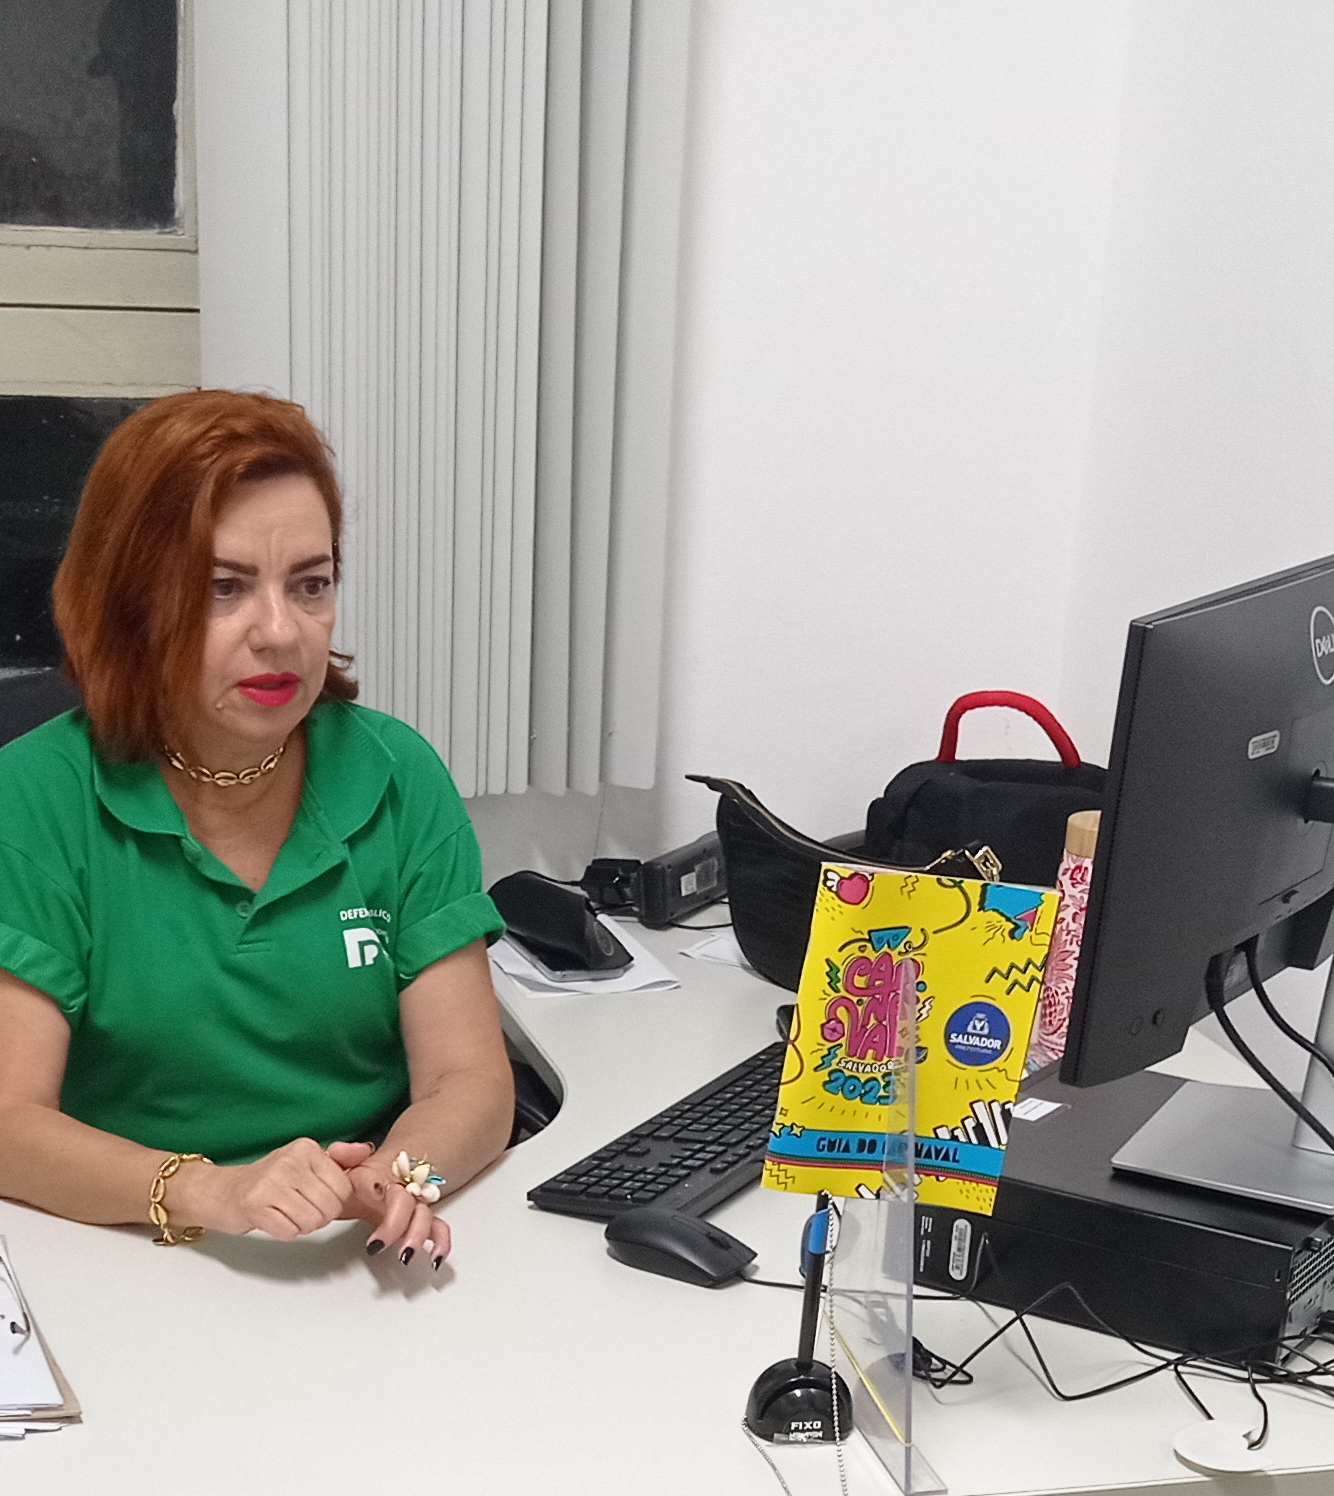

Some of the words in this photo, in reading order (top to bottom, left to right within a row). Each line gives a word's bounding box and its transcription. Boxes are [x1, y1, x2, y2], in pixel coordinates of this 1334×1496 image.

[949, 1032, 1002, 1050] SALVADOR
[816, 1137, 851, 1154] GUIA
[856, 1138, 878, 1155] DO
[790, 1420, 822, 1431] FIXO
